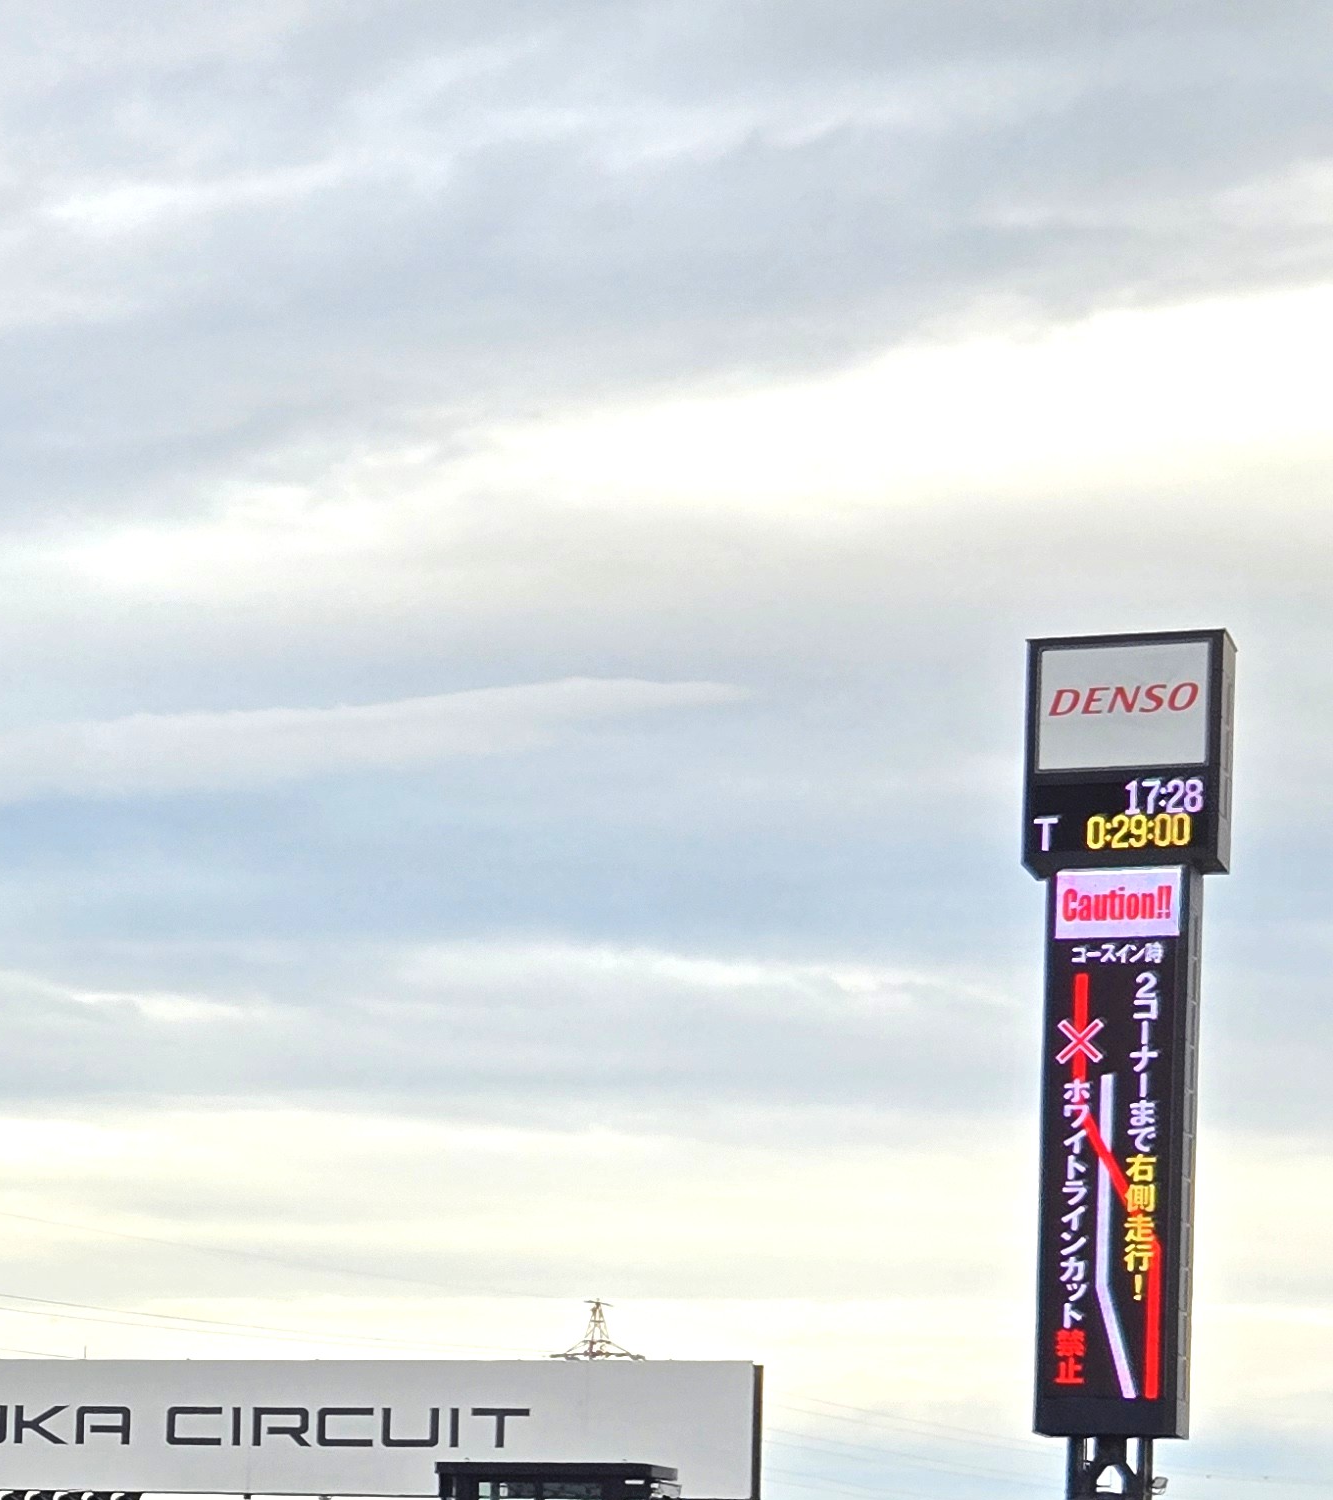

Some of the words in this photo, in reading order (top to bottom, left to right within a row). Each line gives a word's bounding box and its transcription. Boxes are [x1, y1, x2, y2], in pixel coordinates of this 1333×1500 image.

[1048, 682, 1199, 716] DENSO
[1124, 779, 1203, 815] 17:28
[1033, 817, 1059, 851] T
[1086, 813, 1191, 849] 0:29:00
[1062, 885, 1172, 922] Caution!!
[1071, 941, 1163, 964] コースイン時
[166, 1406, 531, 1449] CIRCUIT
